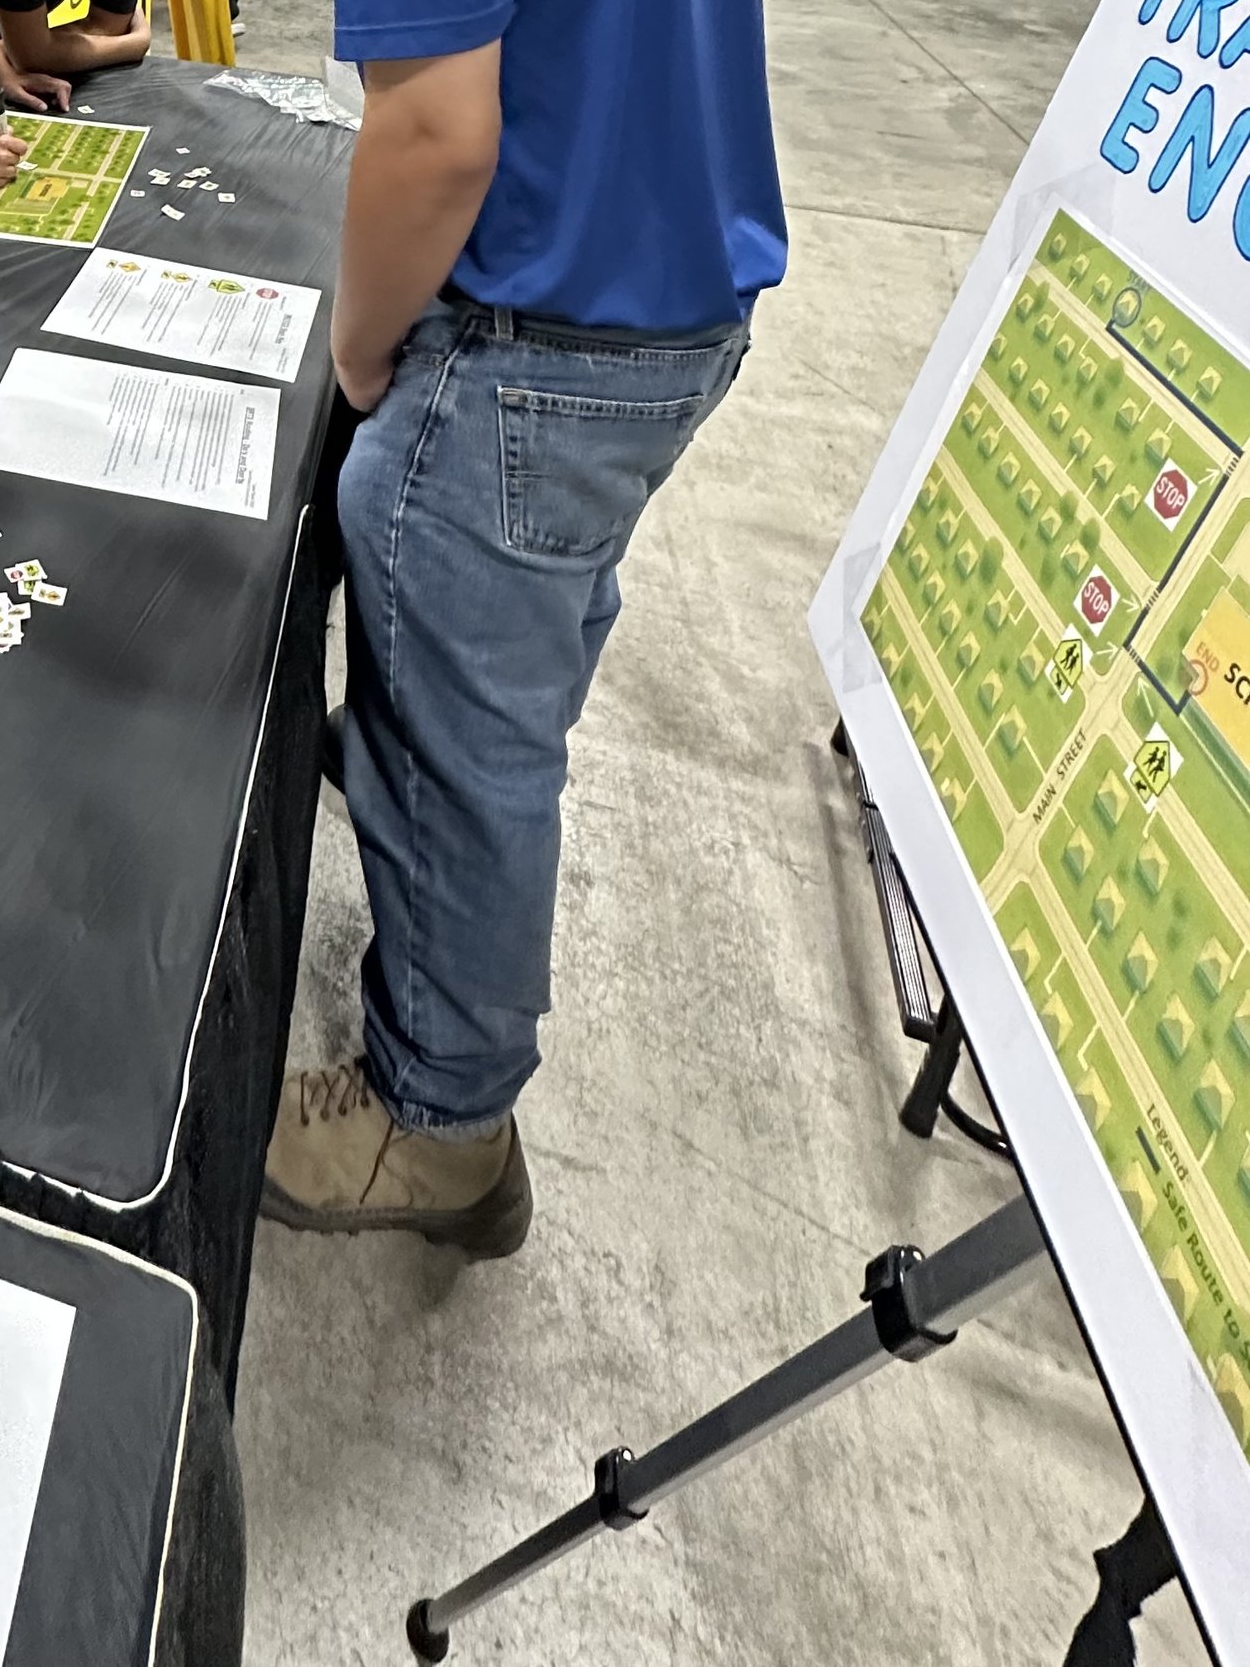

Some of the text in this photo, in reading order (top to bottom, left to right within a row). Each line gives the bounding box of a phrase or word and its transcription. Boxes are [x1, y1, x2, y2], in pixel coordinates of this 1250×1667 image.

[1100, 56, 1250, 262] EN
[1156, 476, 1186, 510] STOP
[1084, 582, 1110, 615] STOP
[1196, 641, 1220, 672] END
[1223, 662, 1250, 705] SC
[1032, 727, 1087, 824] MAIN STREET
[1161, 1181, 1241, 1339] Safe Route to
